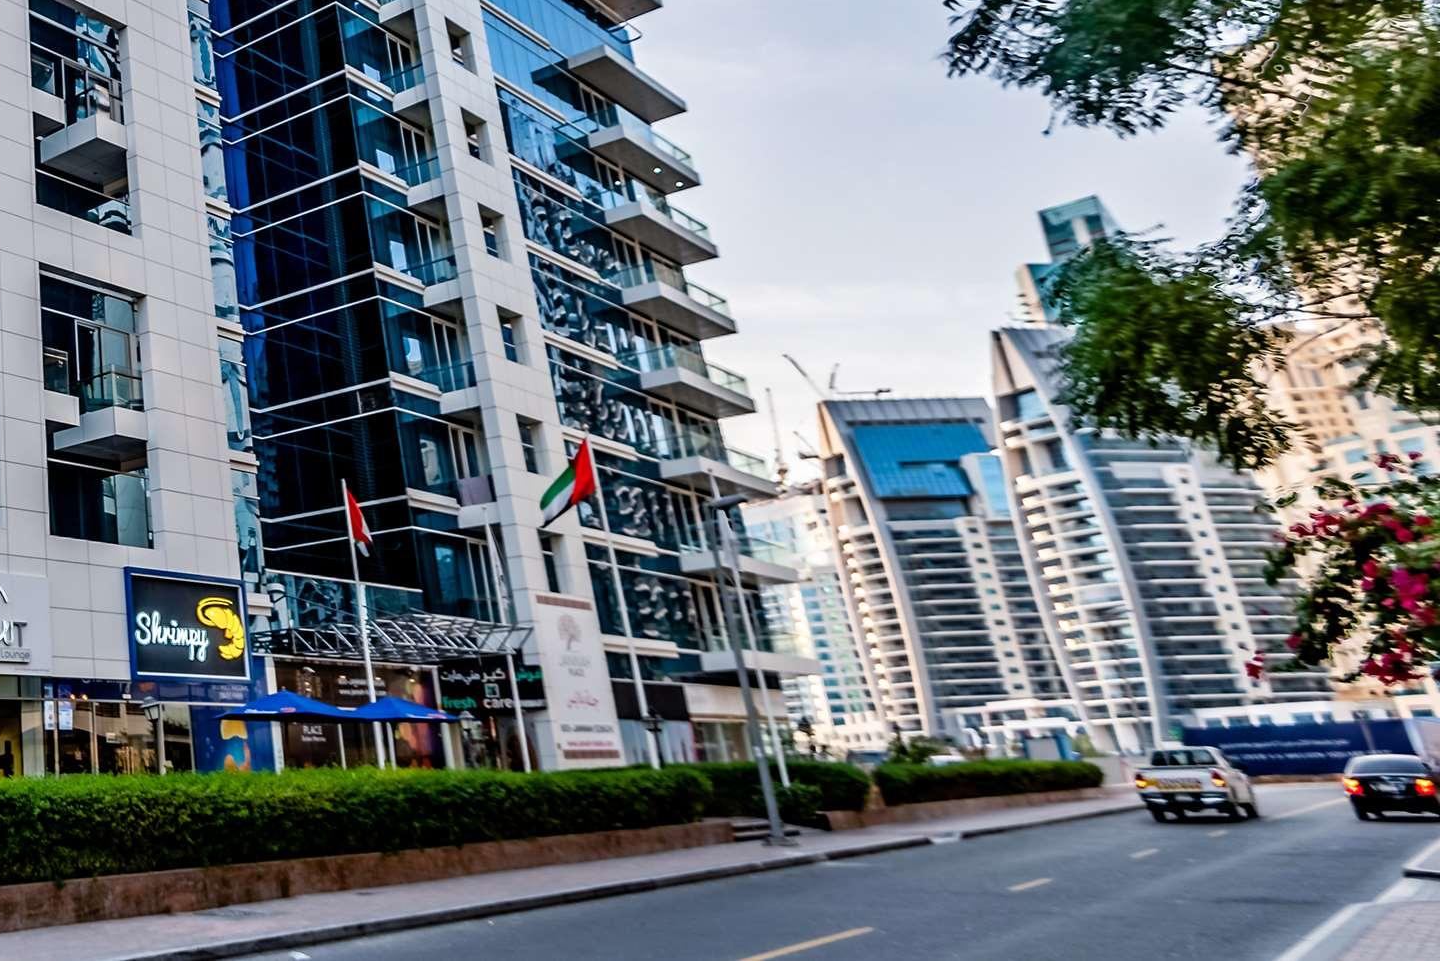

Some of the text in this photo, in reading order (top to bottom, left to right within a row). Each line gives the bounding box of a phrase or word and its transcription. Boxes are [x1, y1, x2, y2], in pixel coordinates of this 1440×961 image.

[135, 611, 209, 662] Shrimpy
[0, 648, 31, 661] Lounge
[441, 695, 477, 709] fresh
[483, 697, 513, 709] care
